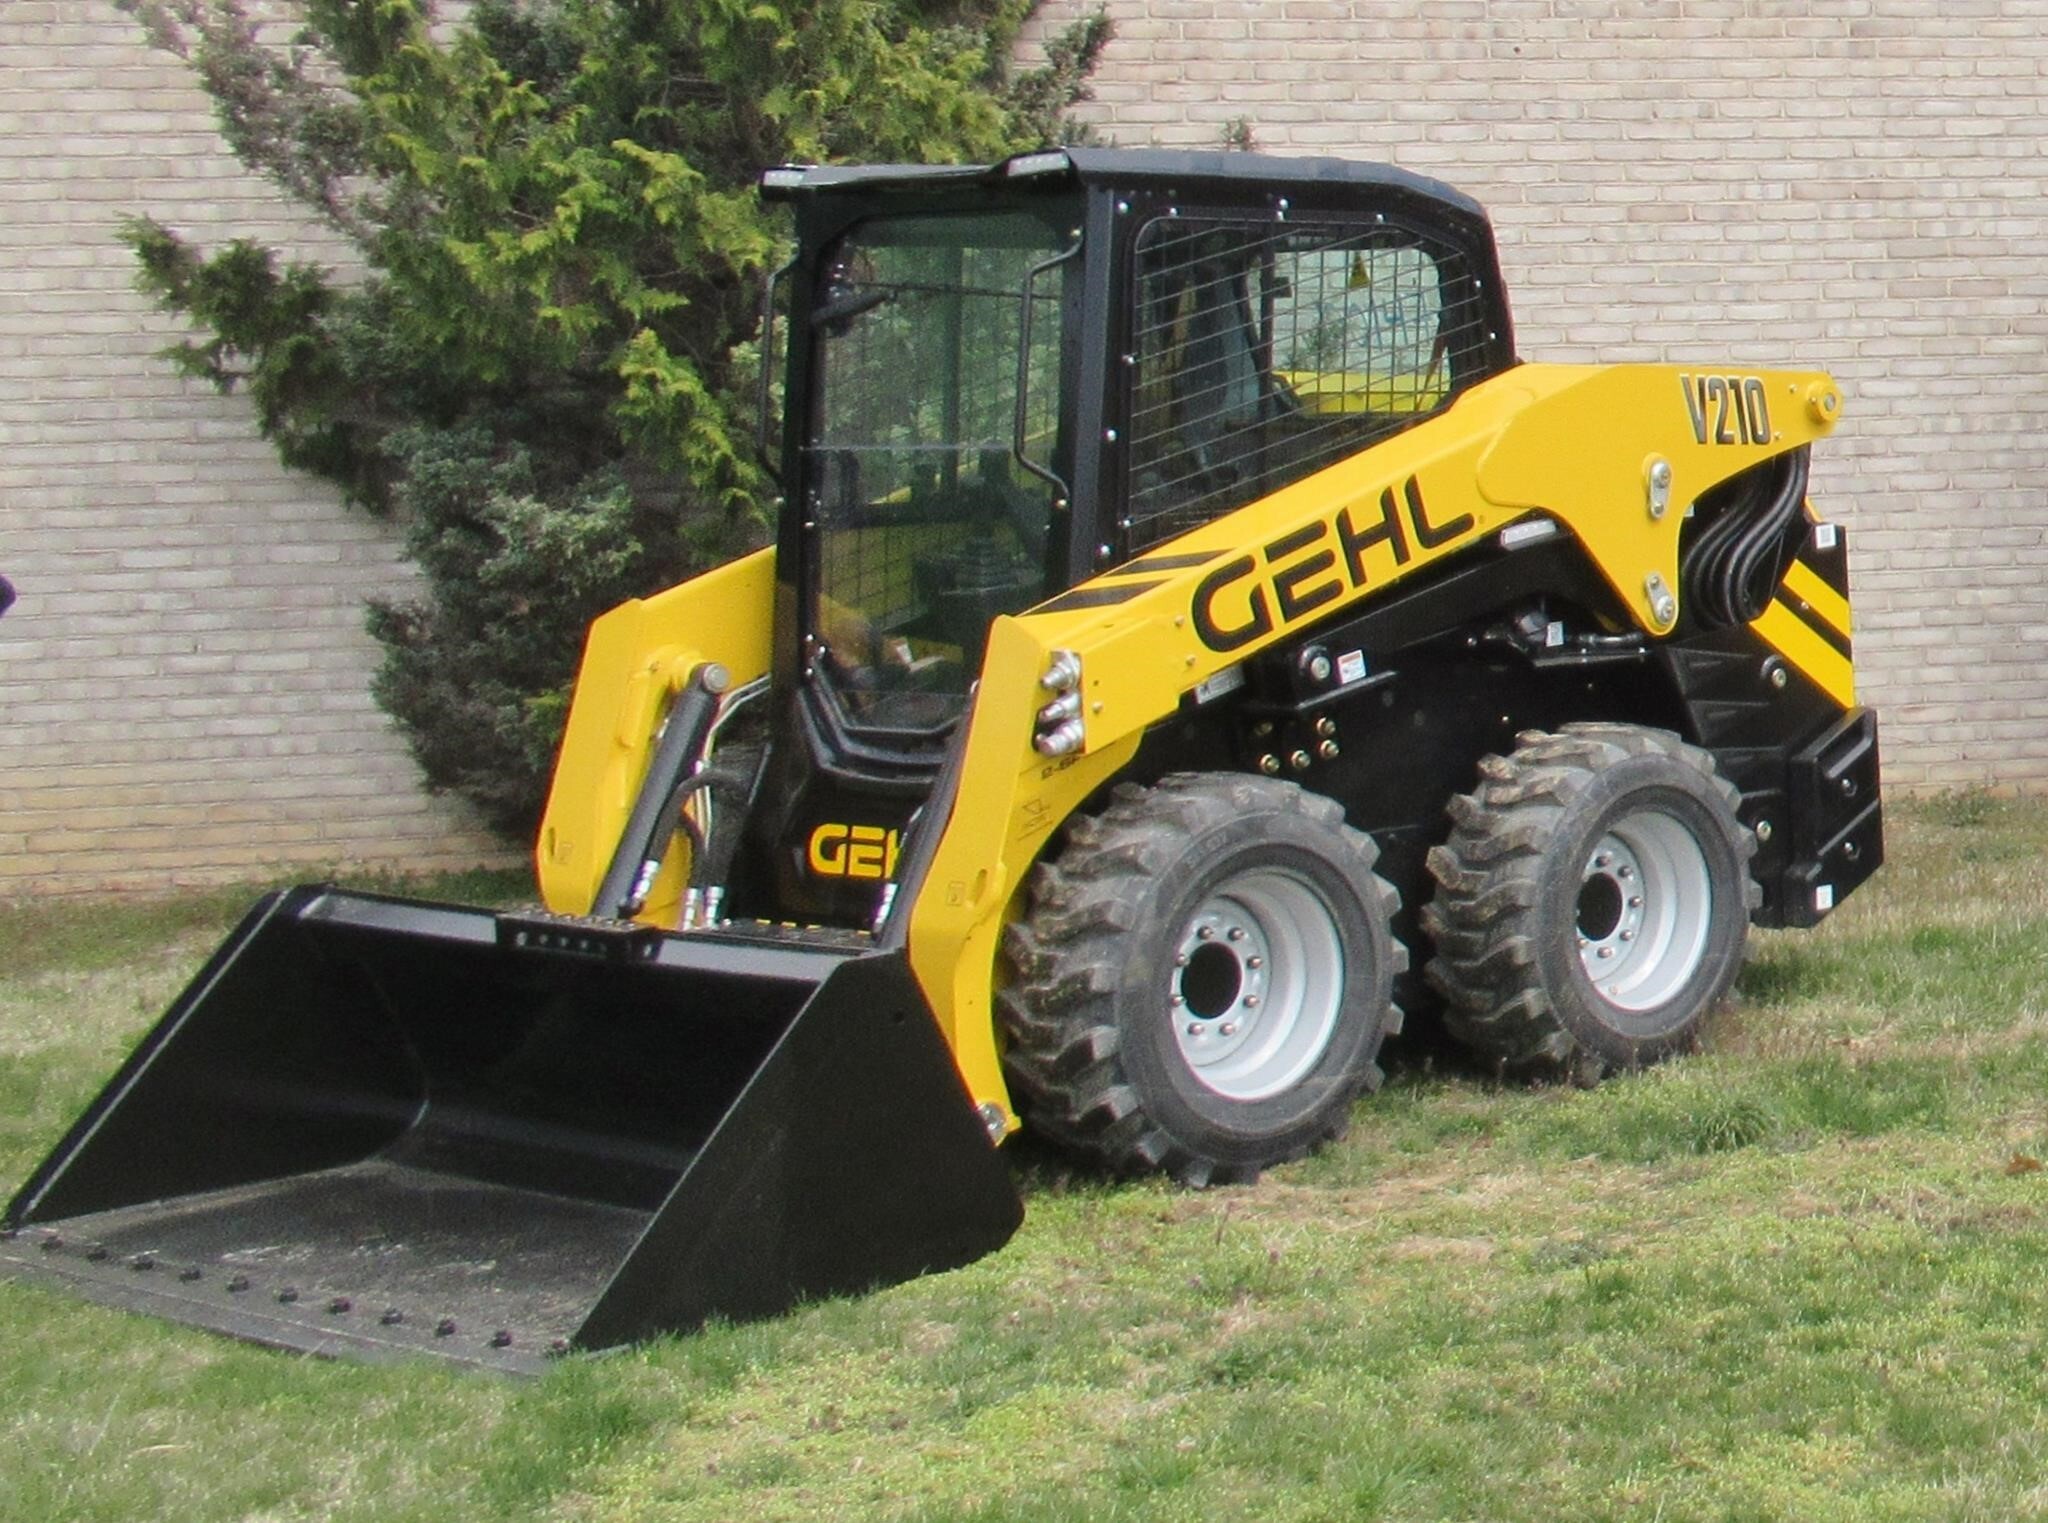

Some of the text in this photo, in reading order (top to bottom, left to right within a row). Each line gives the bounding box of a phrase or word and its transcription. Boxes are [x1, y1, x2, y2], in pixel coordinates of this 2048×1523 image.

[1680, 374, 1771, 446] V210
[1192, 473, 1475, 653] GEHL
[809, 823, 899, 879] GE
